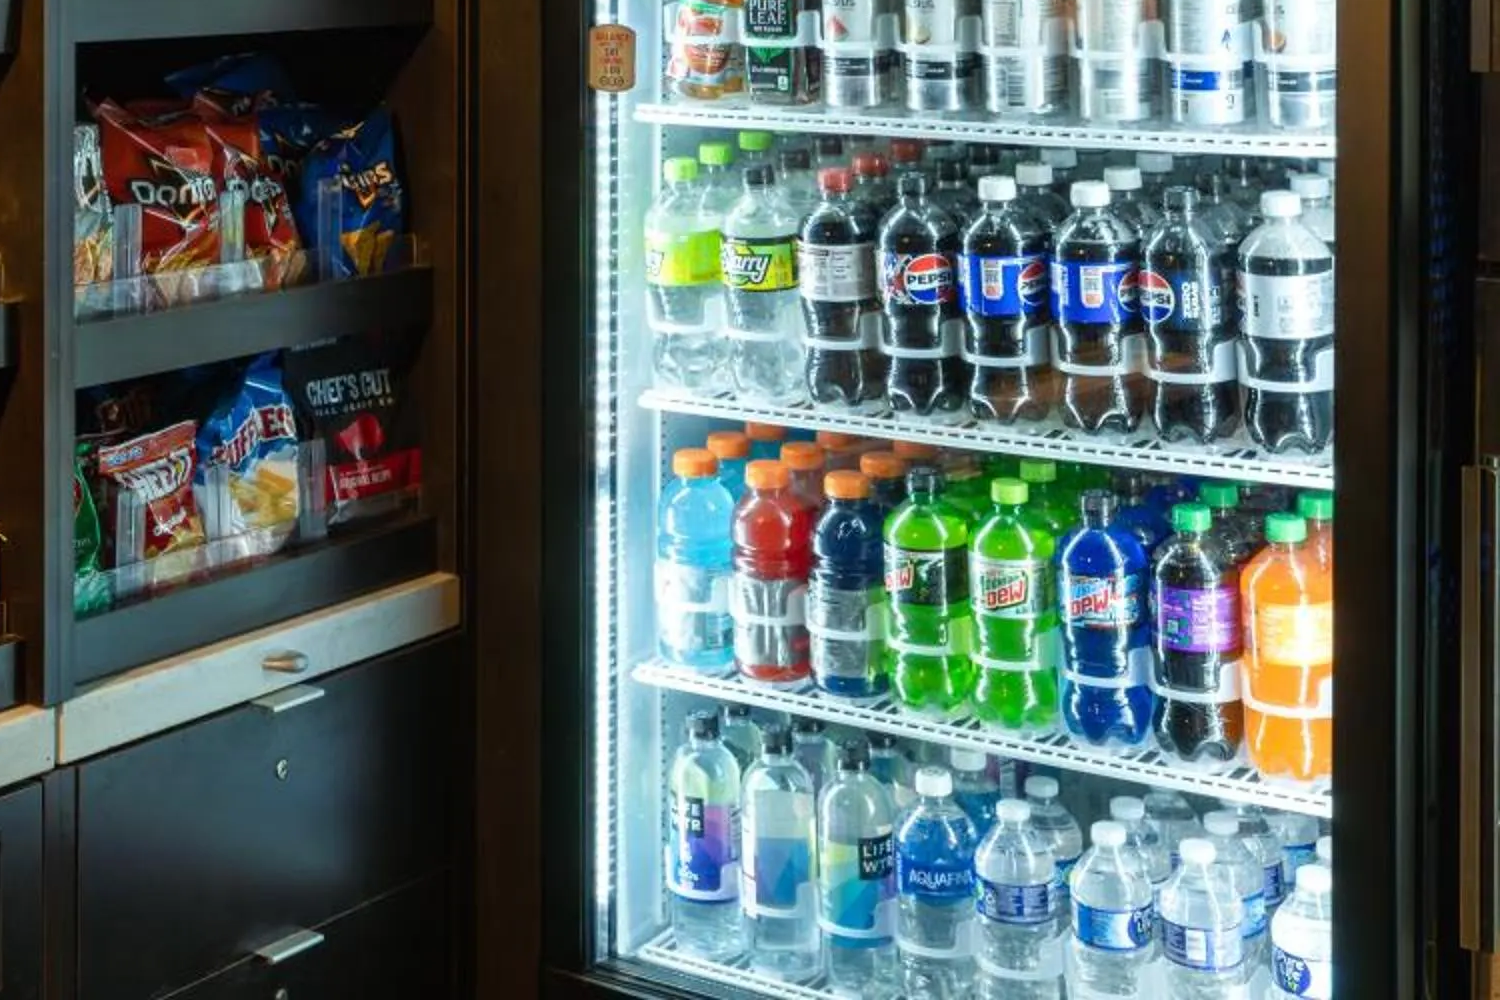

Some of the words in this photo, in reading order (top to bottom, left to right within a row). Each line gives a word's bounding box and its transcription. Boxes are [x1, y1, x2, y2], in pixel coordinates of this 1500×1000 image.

[749, 0, 787, 13] PURE
[749, 12, 784, 25] LEAF
[907, 270, 950, 285] PEPS
[307, 373, 360, 405] CHEF'S
[360, 369, 392, 397] CUT
[908, 867, 975, 890] AQUAFINA
